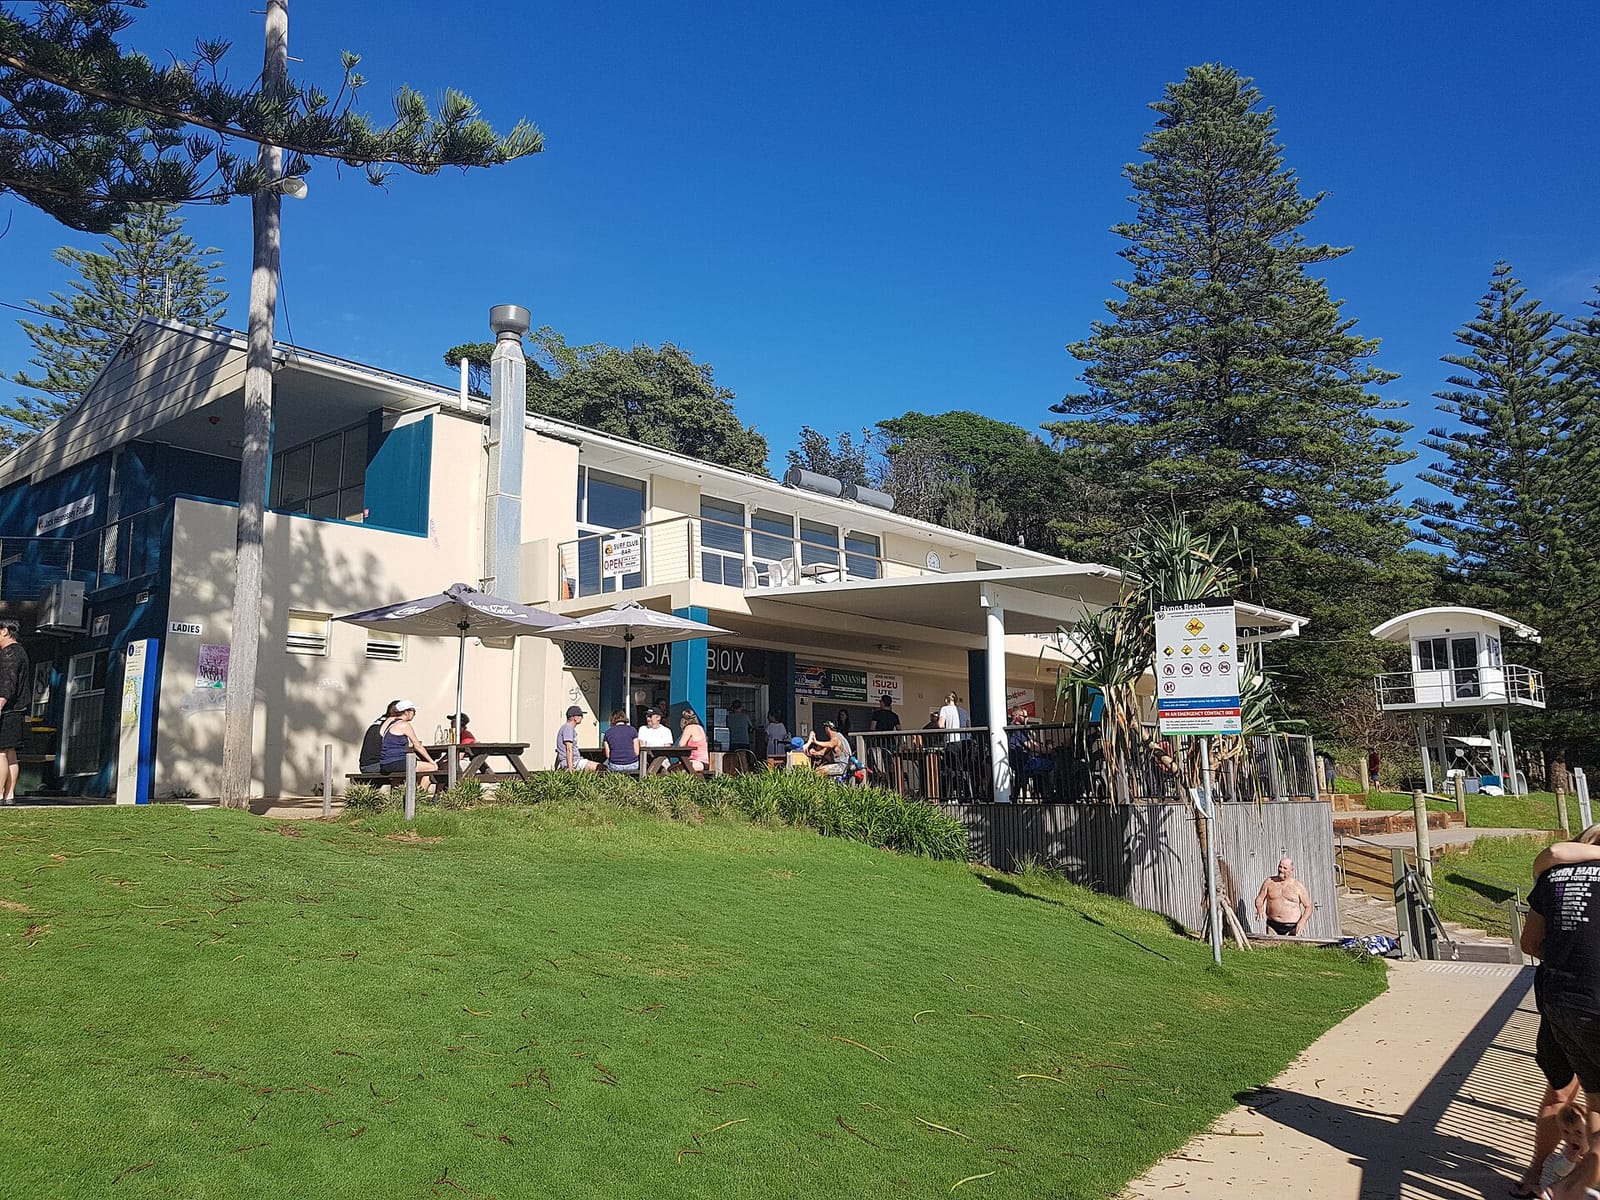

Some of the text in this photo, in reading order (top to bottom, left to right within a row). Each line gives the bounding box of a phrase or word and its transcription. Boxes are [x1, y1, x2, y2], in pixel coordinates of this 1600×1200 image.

[613, 542, 625, 550] SURF
[604, 558, 623, 570] OPEN
[1184, 602, 1206, 610] Beach
[172, 623, 200, 634] LADIES
[872, 680, 898, 689] ISUZU
[1574, 866, 1600, 876] MAY
